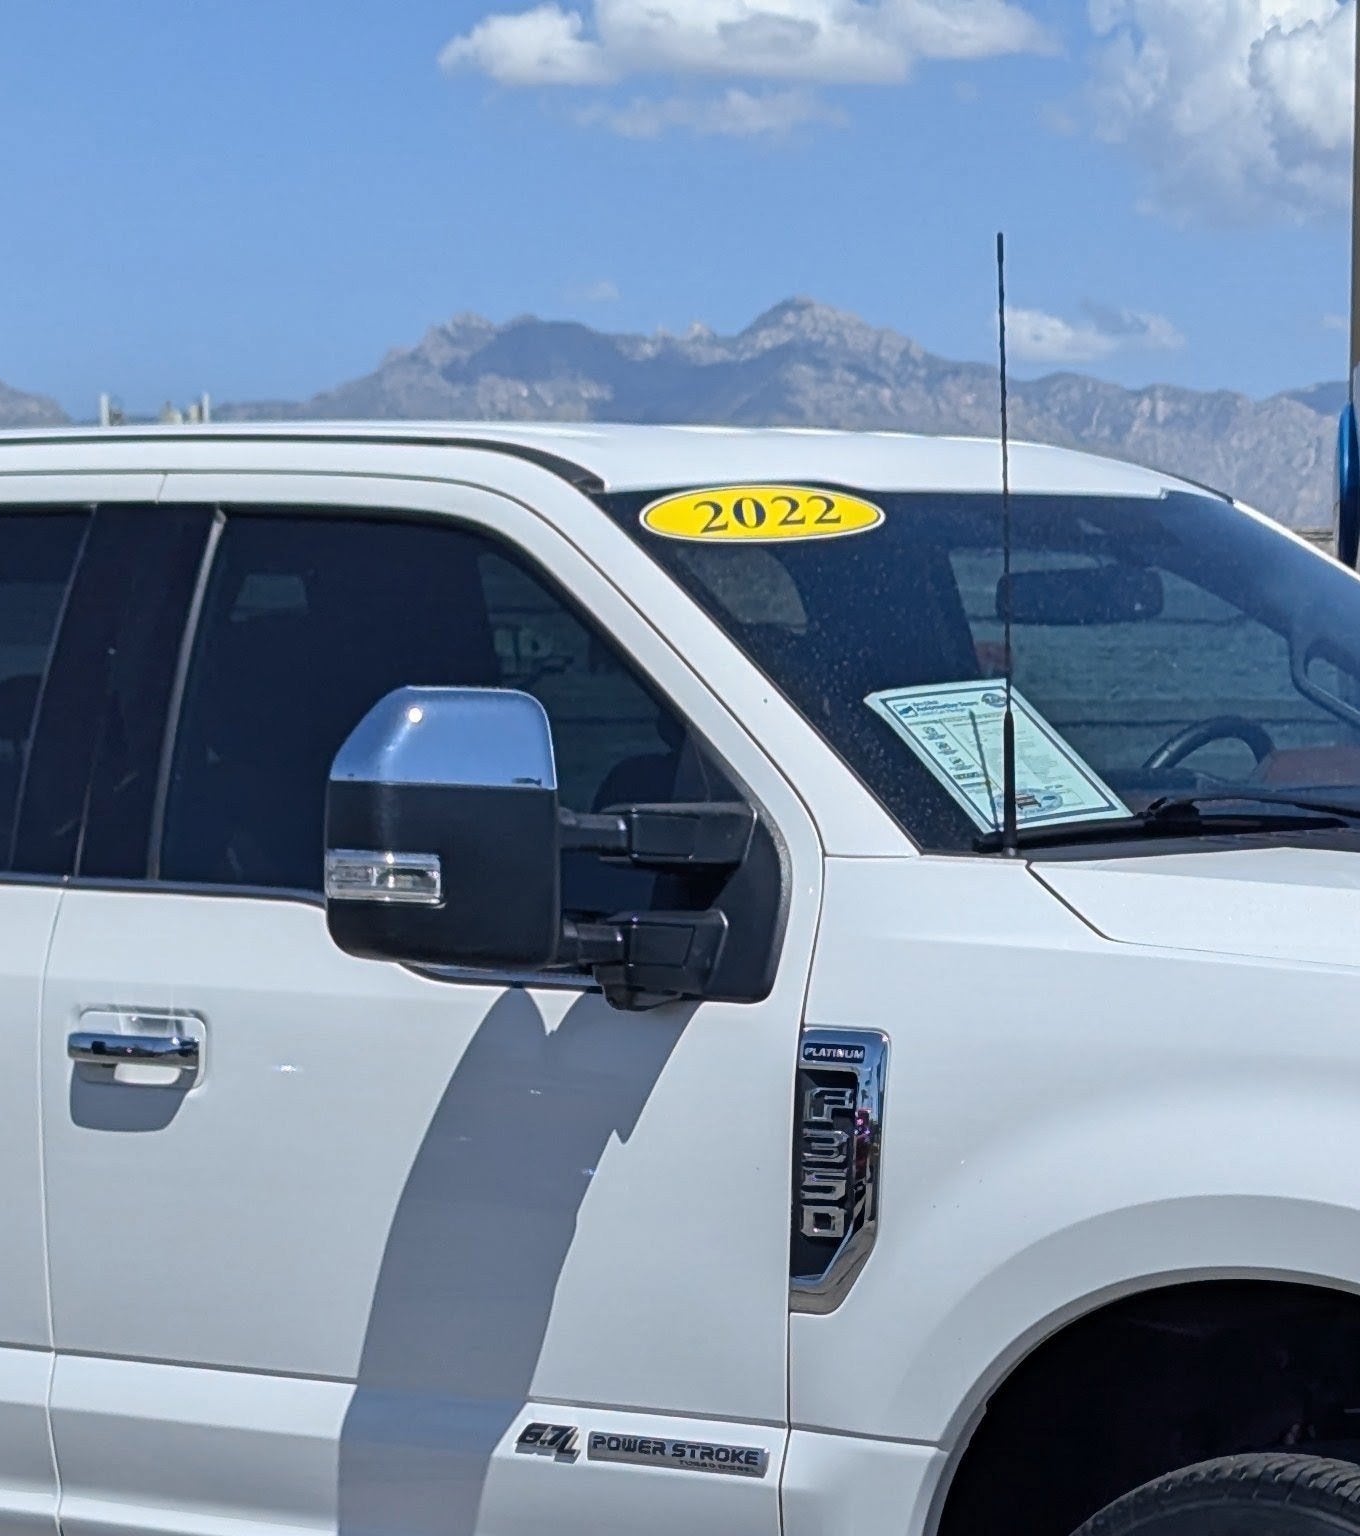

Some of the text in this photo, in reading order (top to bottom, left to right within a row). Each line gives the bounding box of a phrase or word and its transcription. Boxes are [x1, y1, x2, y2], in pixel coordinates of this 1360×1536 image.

[693, 494, 842, 534] 2022
[804, 1046, 865, 1060] PLATINUM
[592, 1433, 760, 1466] POWER STROKE
